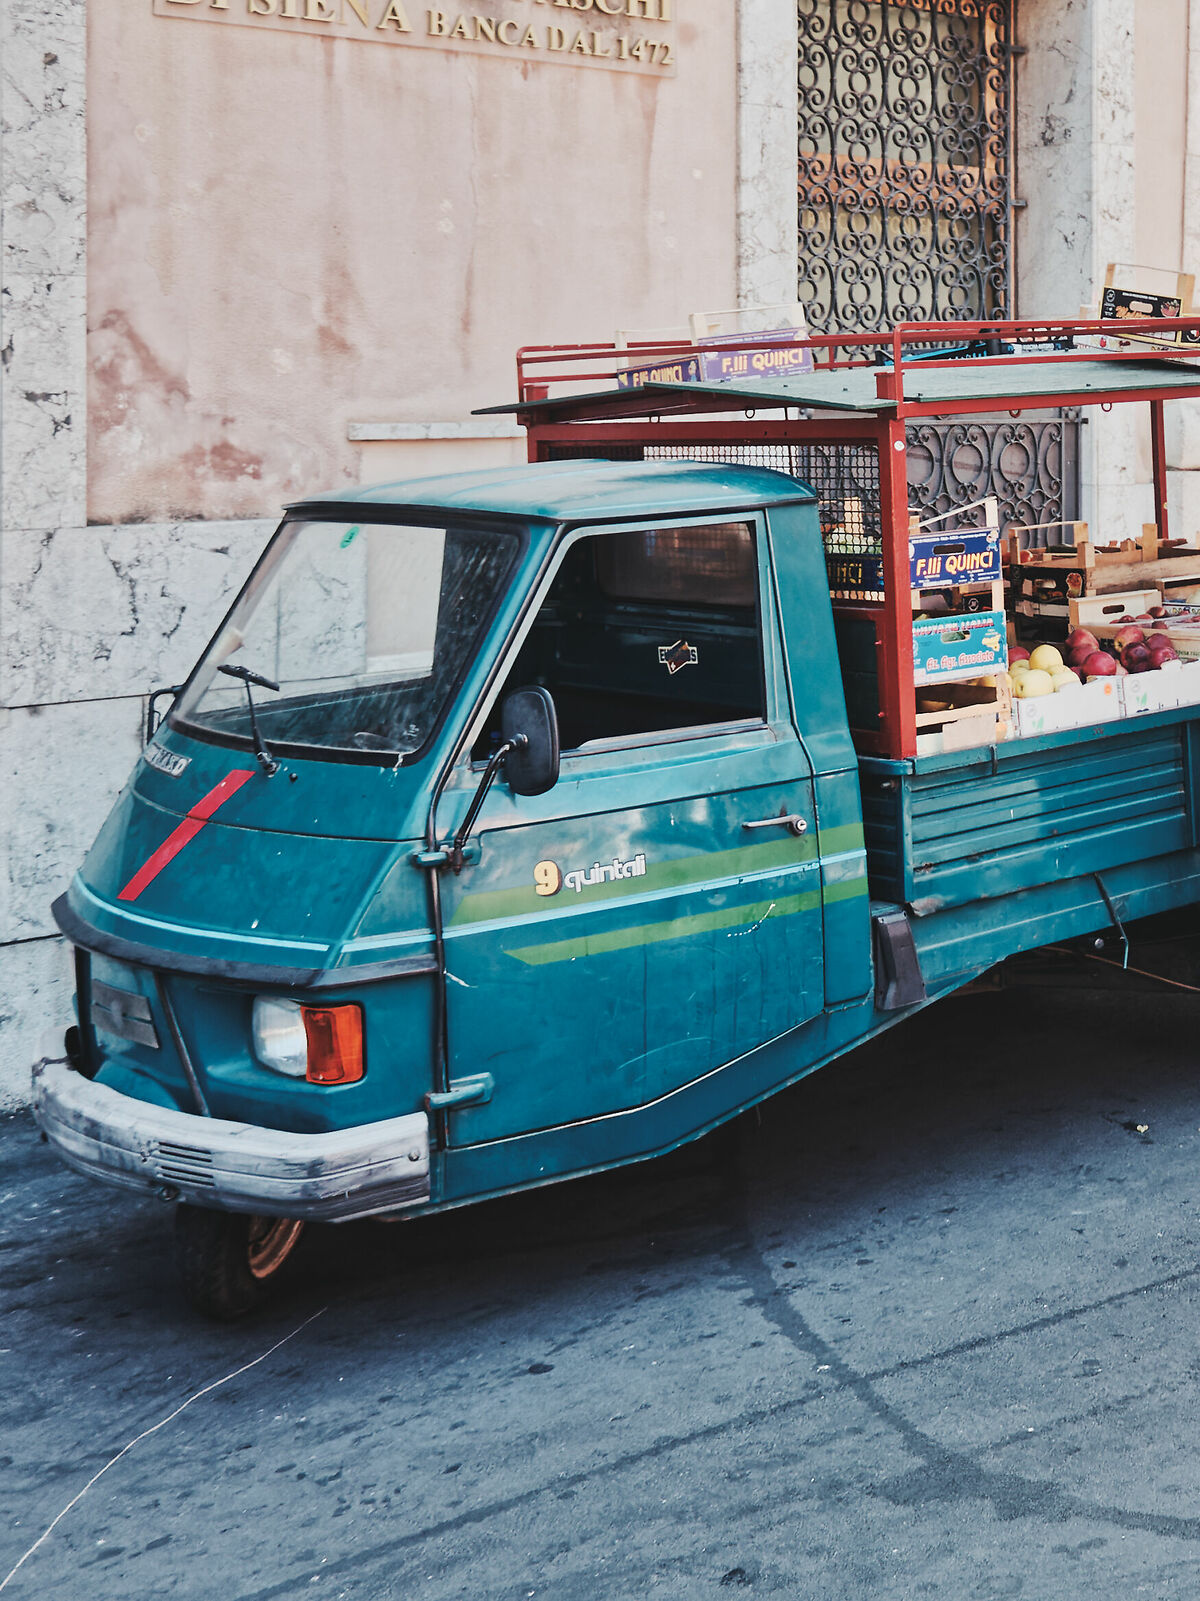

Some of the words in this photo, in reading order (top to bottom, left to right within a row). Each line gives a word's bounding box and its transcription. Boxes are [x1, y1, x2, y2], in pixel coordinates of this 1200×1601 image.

[427, 9, 541, 49] BANCA
[547, 26, 611, 58] DAL
[617, 36, 676, 65] 1472
[752, 348, 803, 371] QUINCI
[916, 556, 942, 577] F.lli
[945, 551, 994, 575] QUINCI
[534, 860, 562, 896] 9
[564, 853, 646, 893] quintali
